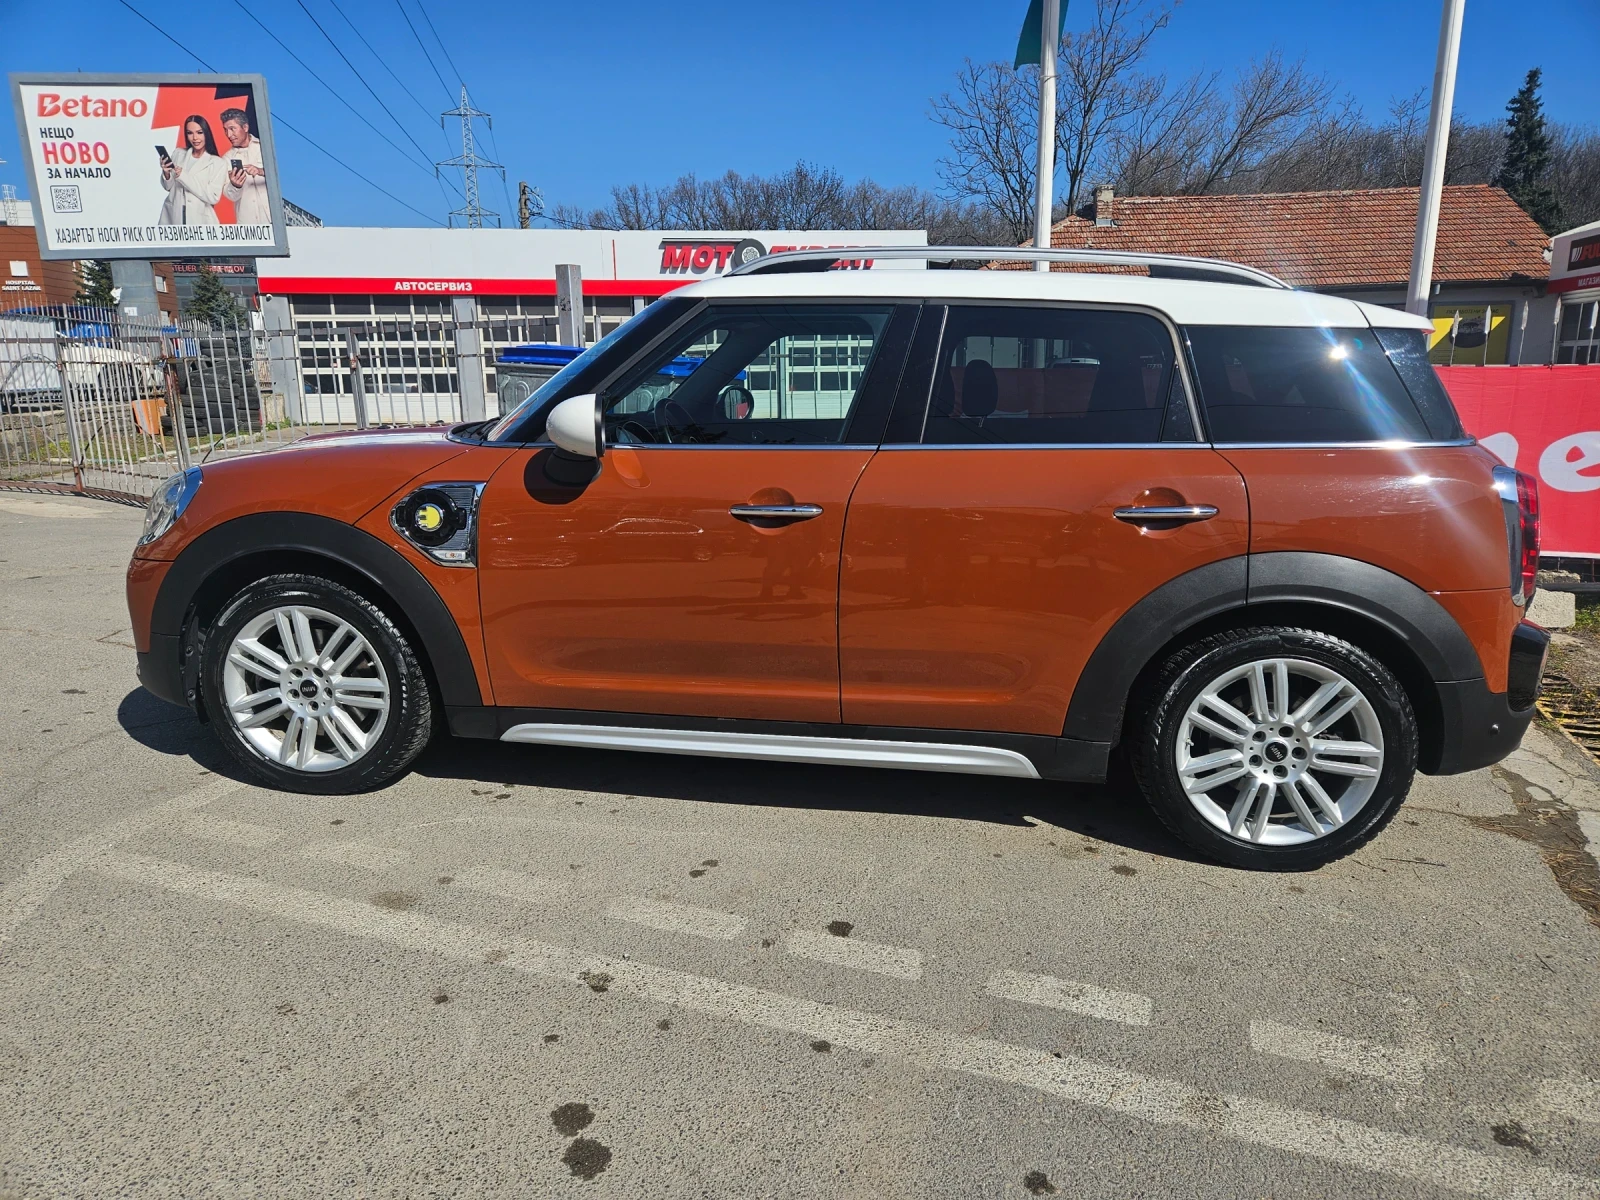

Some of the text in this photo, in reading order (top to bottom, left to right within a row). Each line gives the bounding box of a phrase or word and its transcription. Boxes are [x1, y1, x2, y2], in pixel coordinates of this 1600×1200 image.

[37, 93, 148, 118] Betano
[40, 127, 75, 140] НЕЩО
[42, 142, 110, 165] НОВО
[47, 167, 111, 179] ЗА НАЧАЛО
[56, 225, 271, 243] ХАЗАРТЪТ НОСИ РИСК ОТ РАЗВИВАНЕ НА ЗАВИСИМОСТ
[394, 282, 472, 291] АВТОСЕРВИЗ
[1269, 744, 1284, 760] MINI
